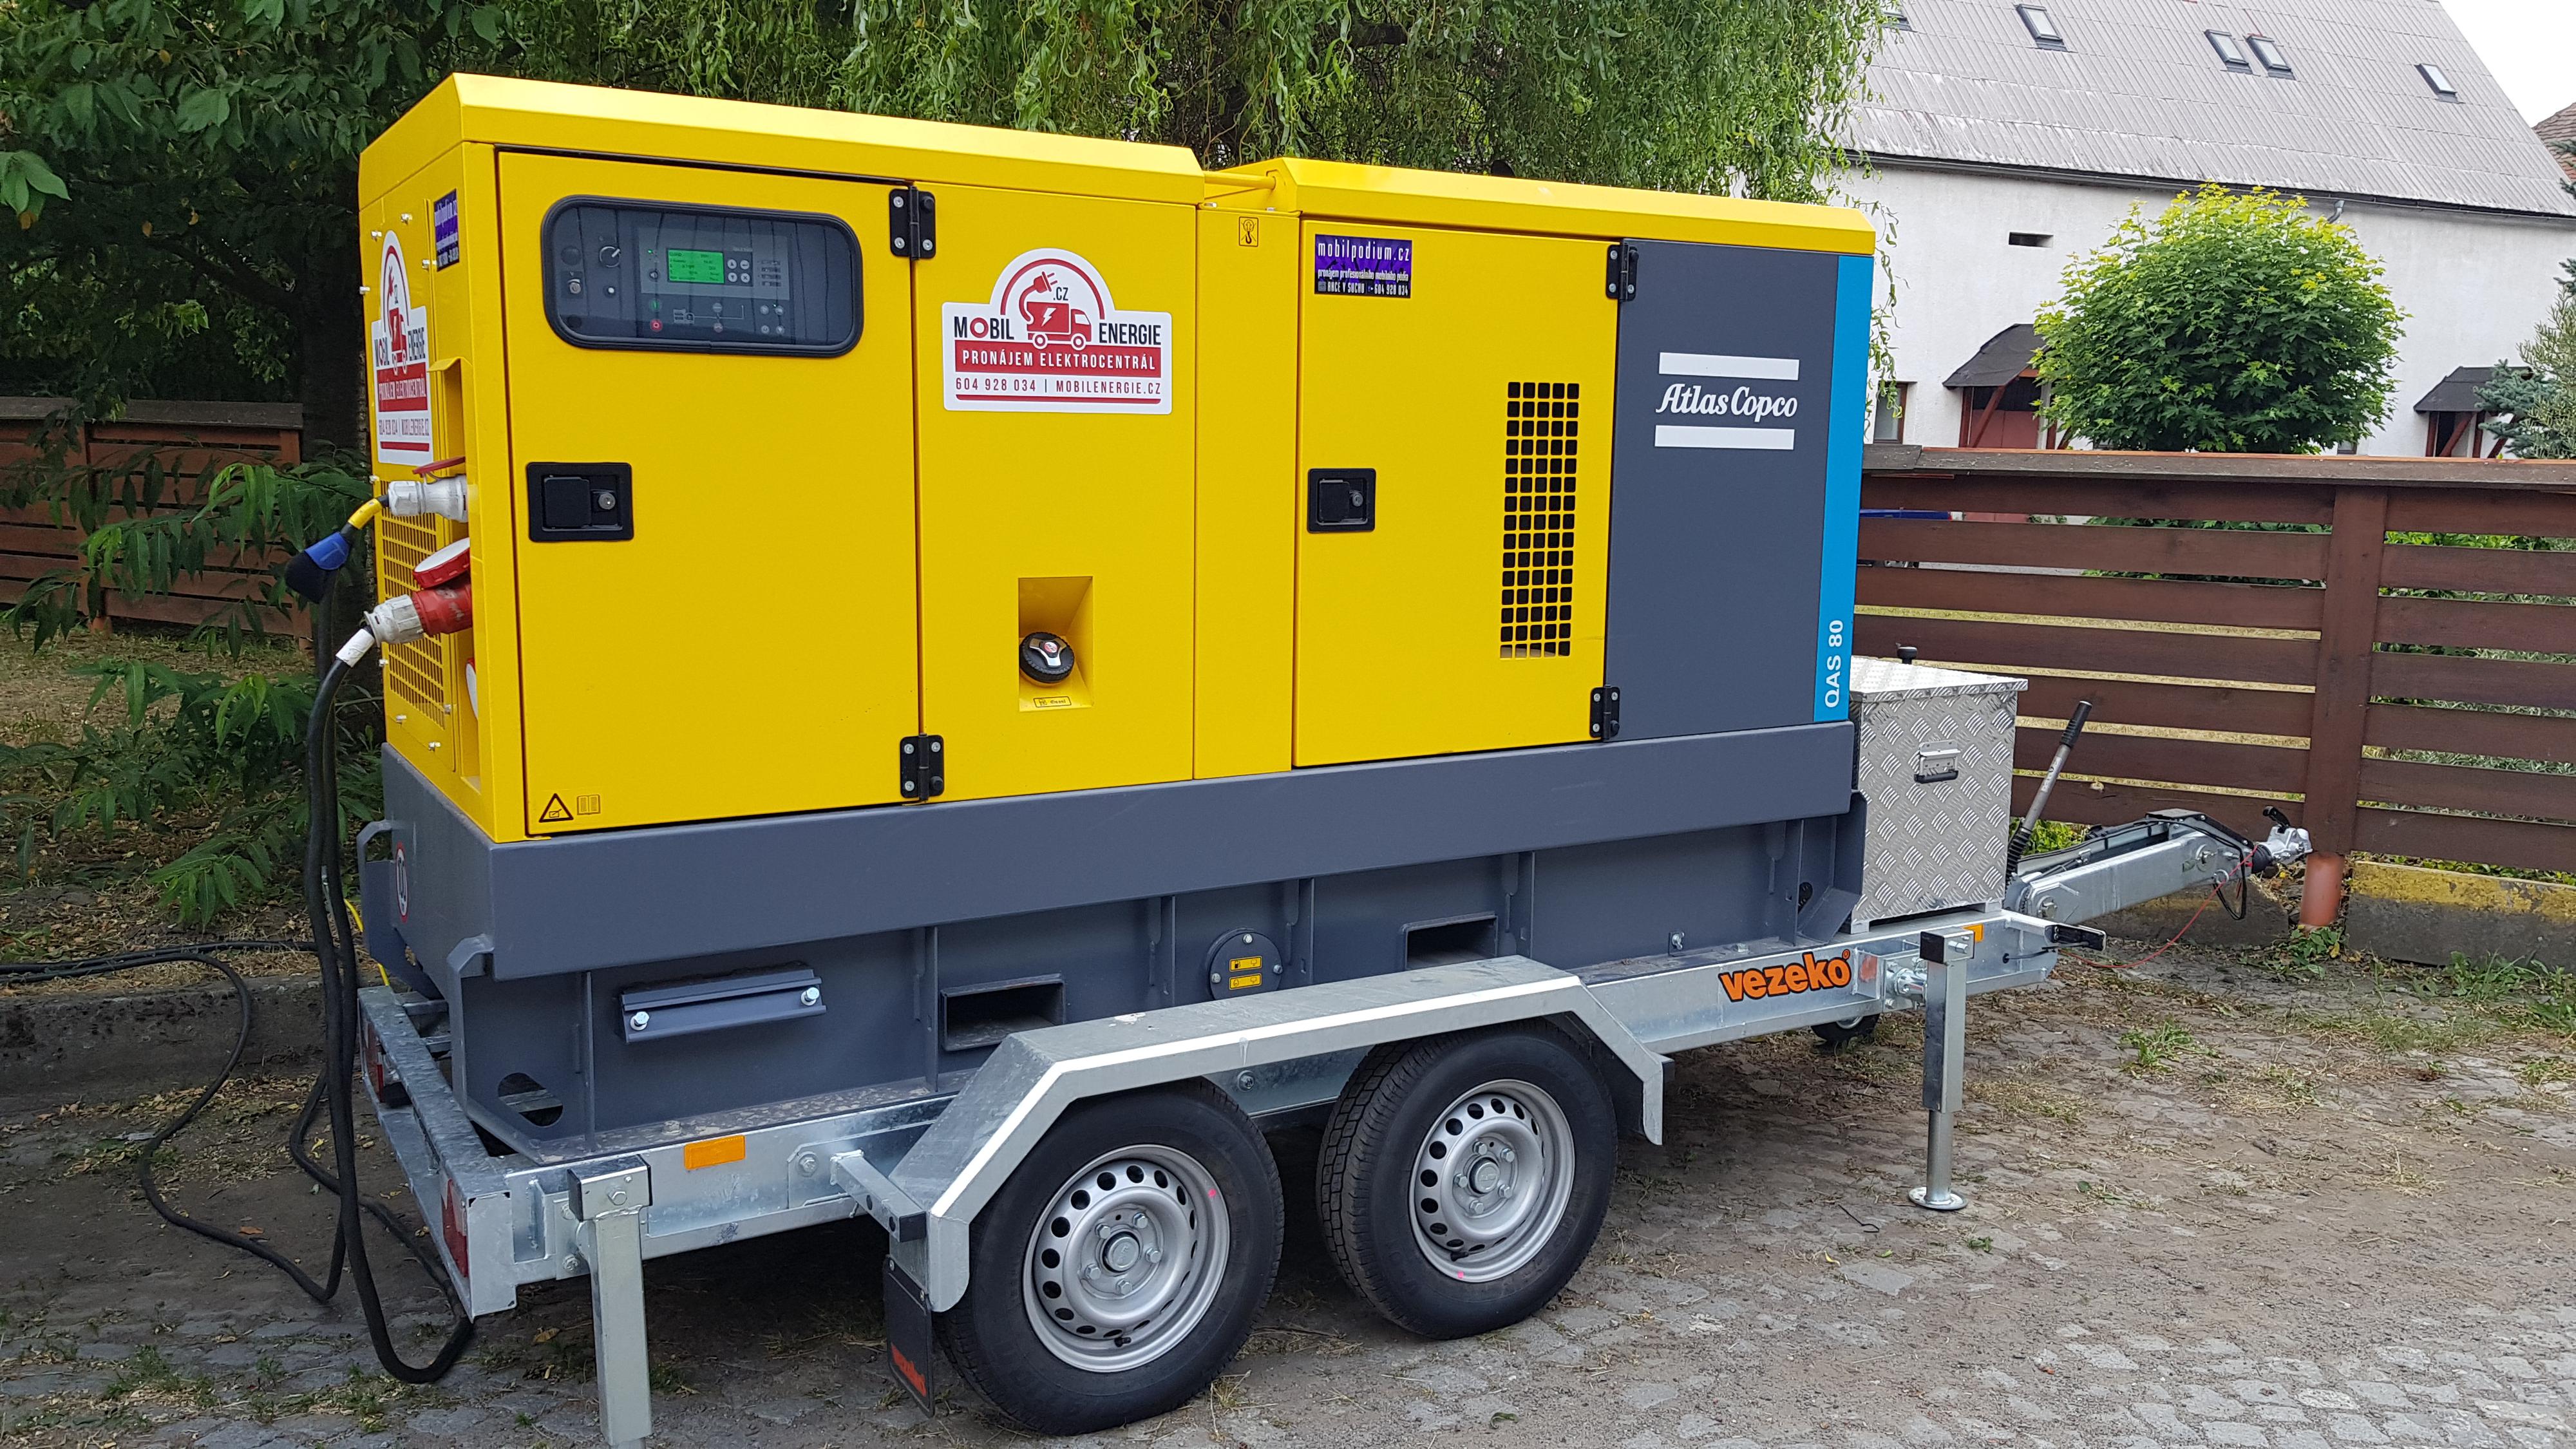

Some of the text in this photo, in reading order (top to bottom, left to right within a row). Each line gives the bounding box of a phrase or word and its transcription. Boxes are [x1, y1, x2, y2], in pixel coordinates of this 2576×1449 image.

[1318, 239, 1409, 262] mobilpodium.cz
[1374, 283, 1385, 295] 604
[1398, 285, 1408, 296] 034
[954, 316, 1162, 346] MOBIL ENERGIE
[962, 349, 1156, 370] PRONÁJEM ELEKTROCENTRÁL
[956, 377, 1161, 395] 604 928 034 MOBILENERGIE.CZ
[1655, 383, 1798, 422] Atlas Copco
[1824, 620, 1843, 708] QAS 80
